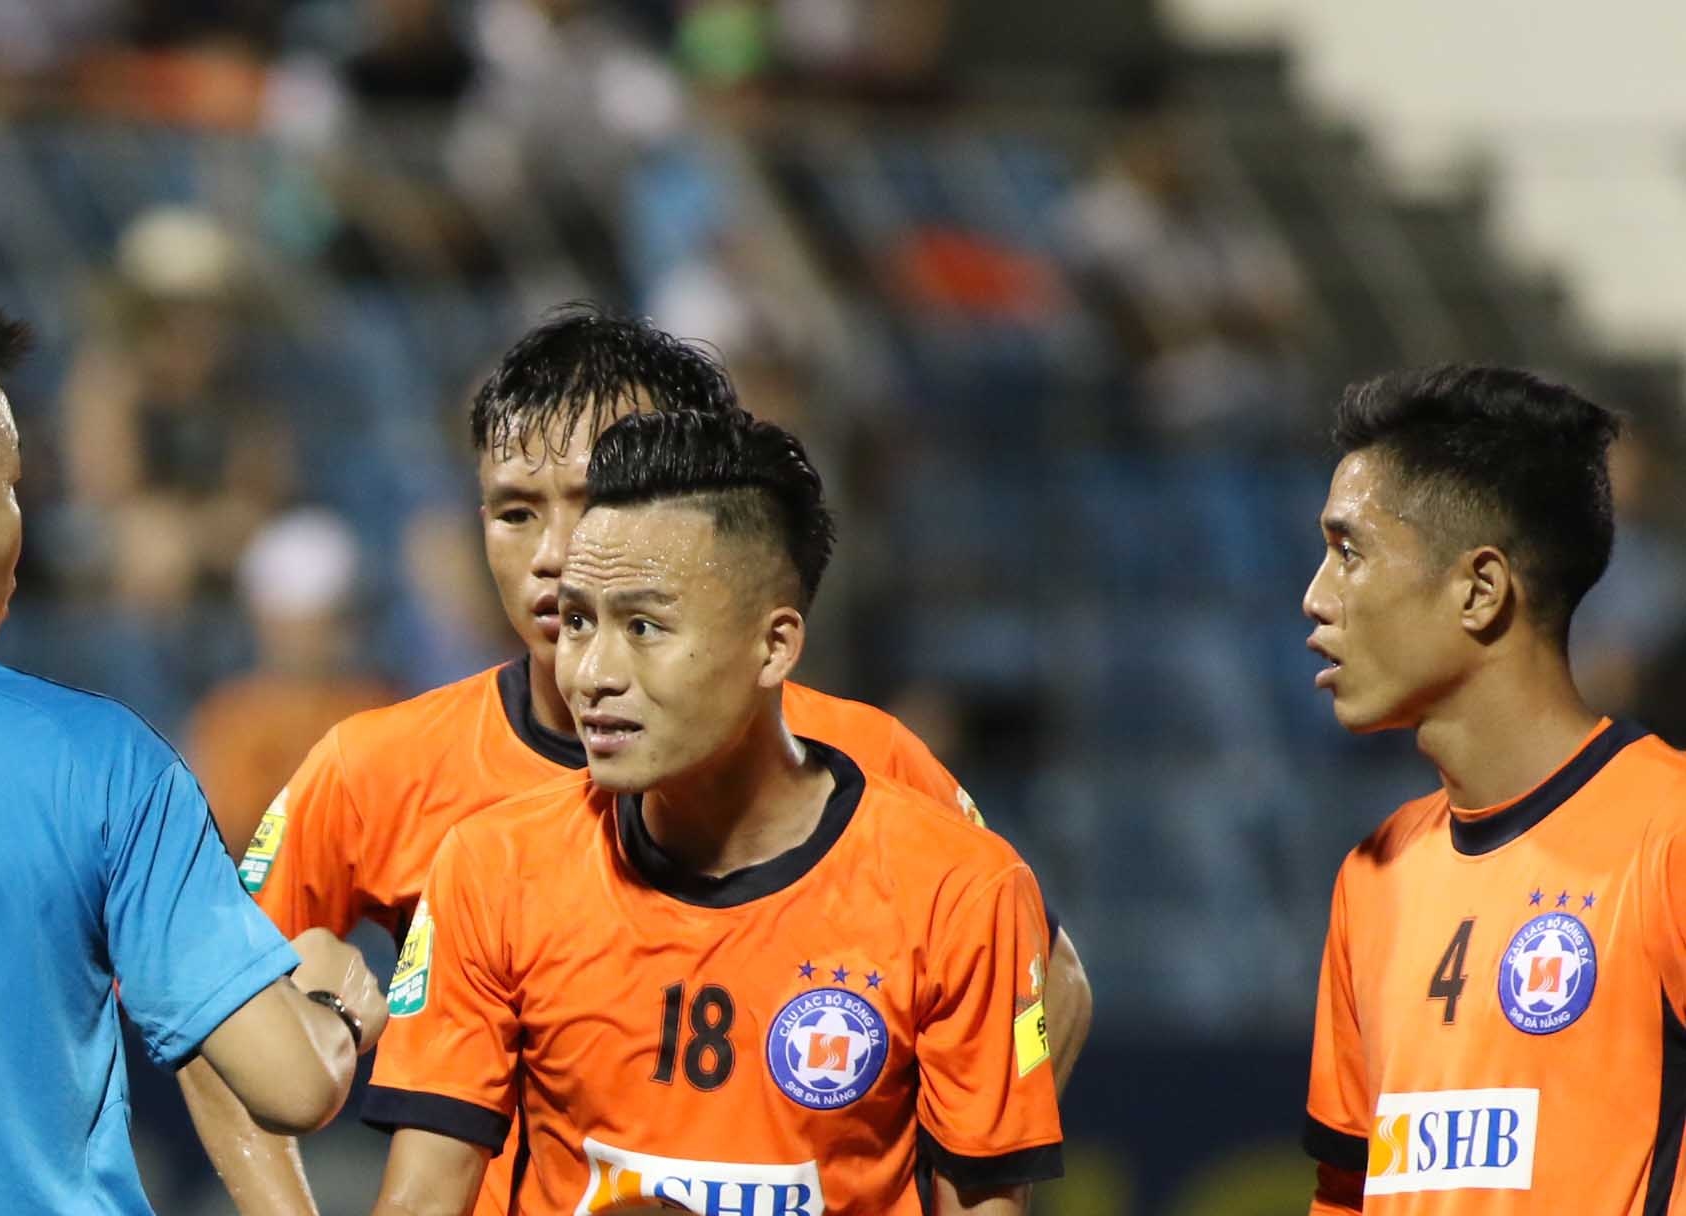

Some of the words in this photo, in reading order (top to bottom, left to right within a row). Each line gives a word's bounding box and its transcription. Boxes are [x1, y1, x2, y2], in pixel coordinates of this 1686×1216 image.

[1426, 915, 1477, 1026] 4
[649, 978, 736, 1093] 18
[1417, 1107, 1519, 1172] SHB
